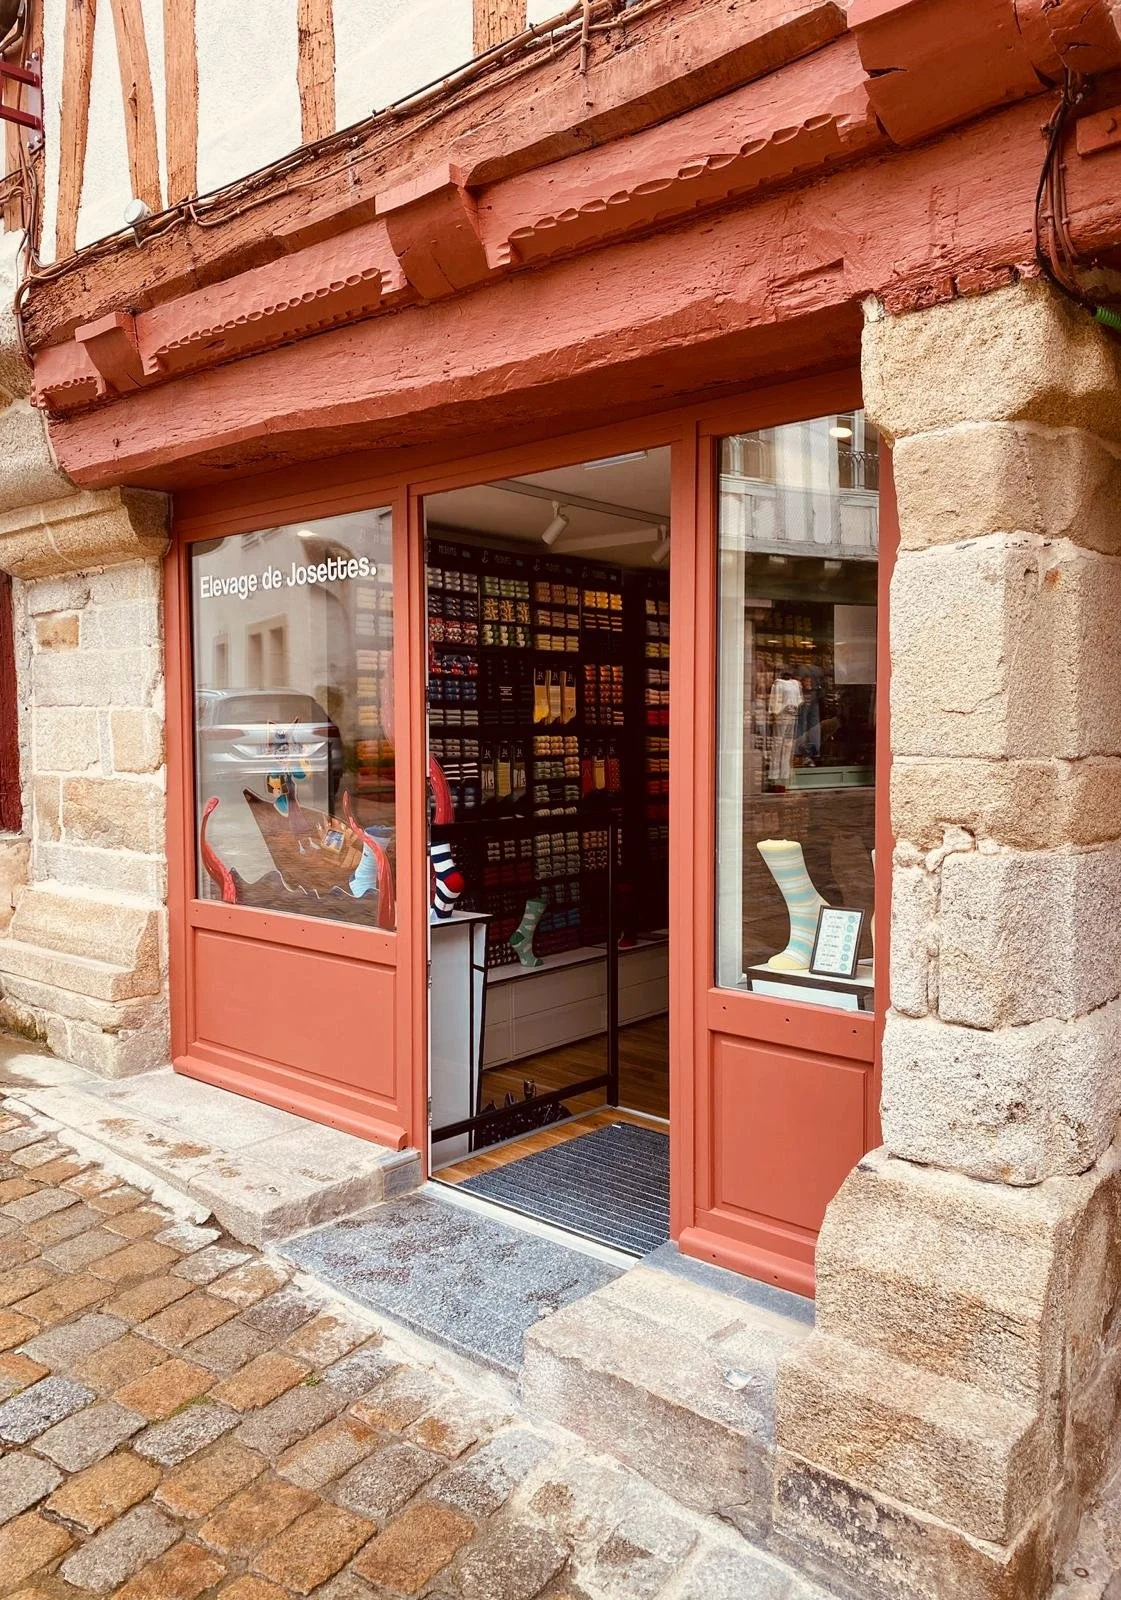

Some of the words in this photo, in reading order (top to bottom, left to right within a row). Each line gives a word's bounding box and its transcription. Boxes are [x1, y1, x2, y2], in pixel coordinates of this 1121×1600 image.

[200, 573, 257, 600] Elevage
[262, 565, 282, 590] de
[286, 556, 377, 587] Josettes.
